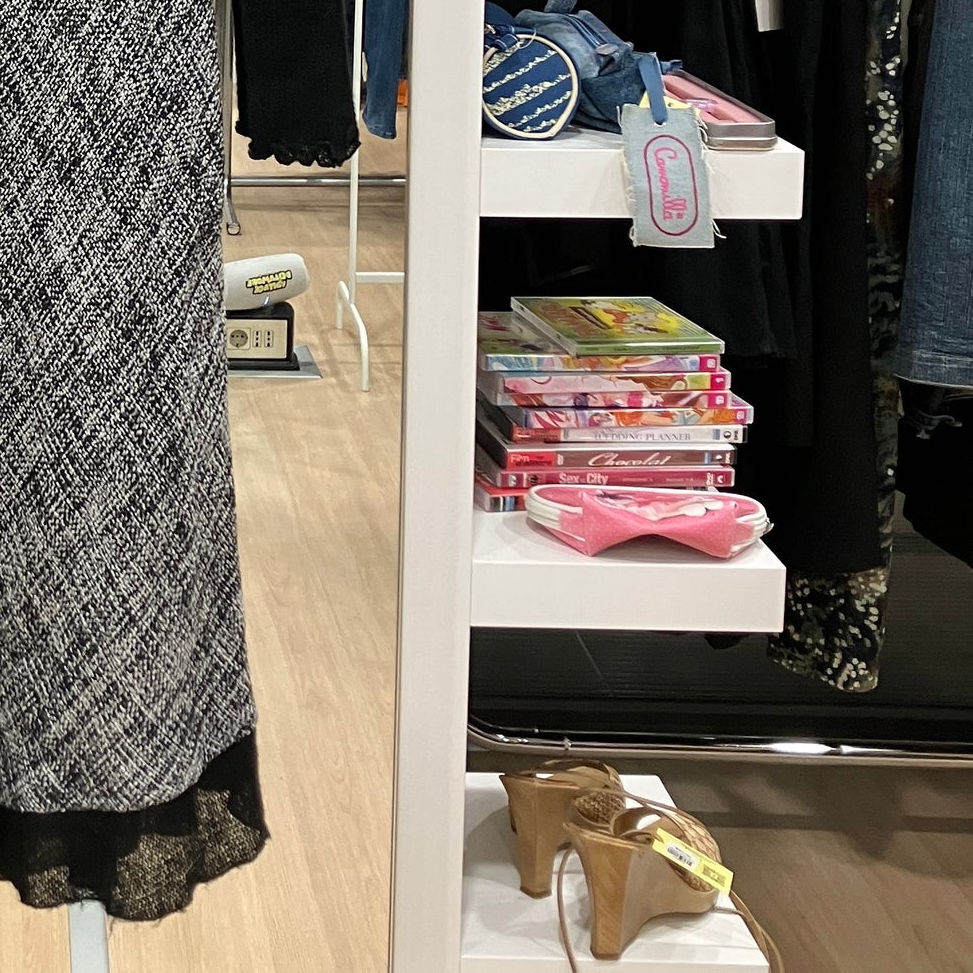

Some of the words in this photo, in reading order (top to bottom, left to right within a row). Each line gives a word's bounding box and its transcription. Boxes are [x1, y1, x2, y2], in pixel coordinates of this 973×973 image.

[646, 432, 692, 442] PLANNER
[588, 451, 672, 467] Chocolat
[558, 472, 580, 484] Sex
[587, 471, 609, 485] City
